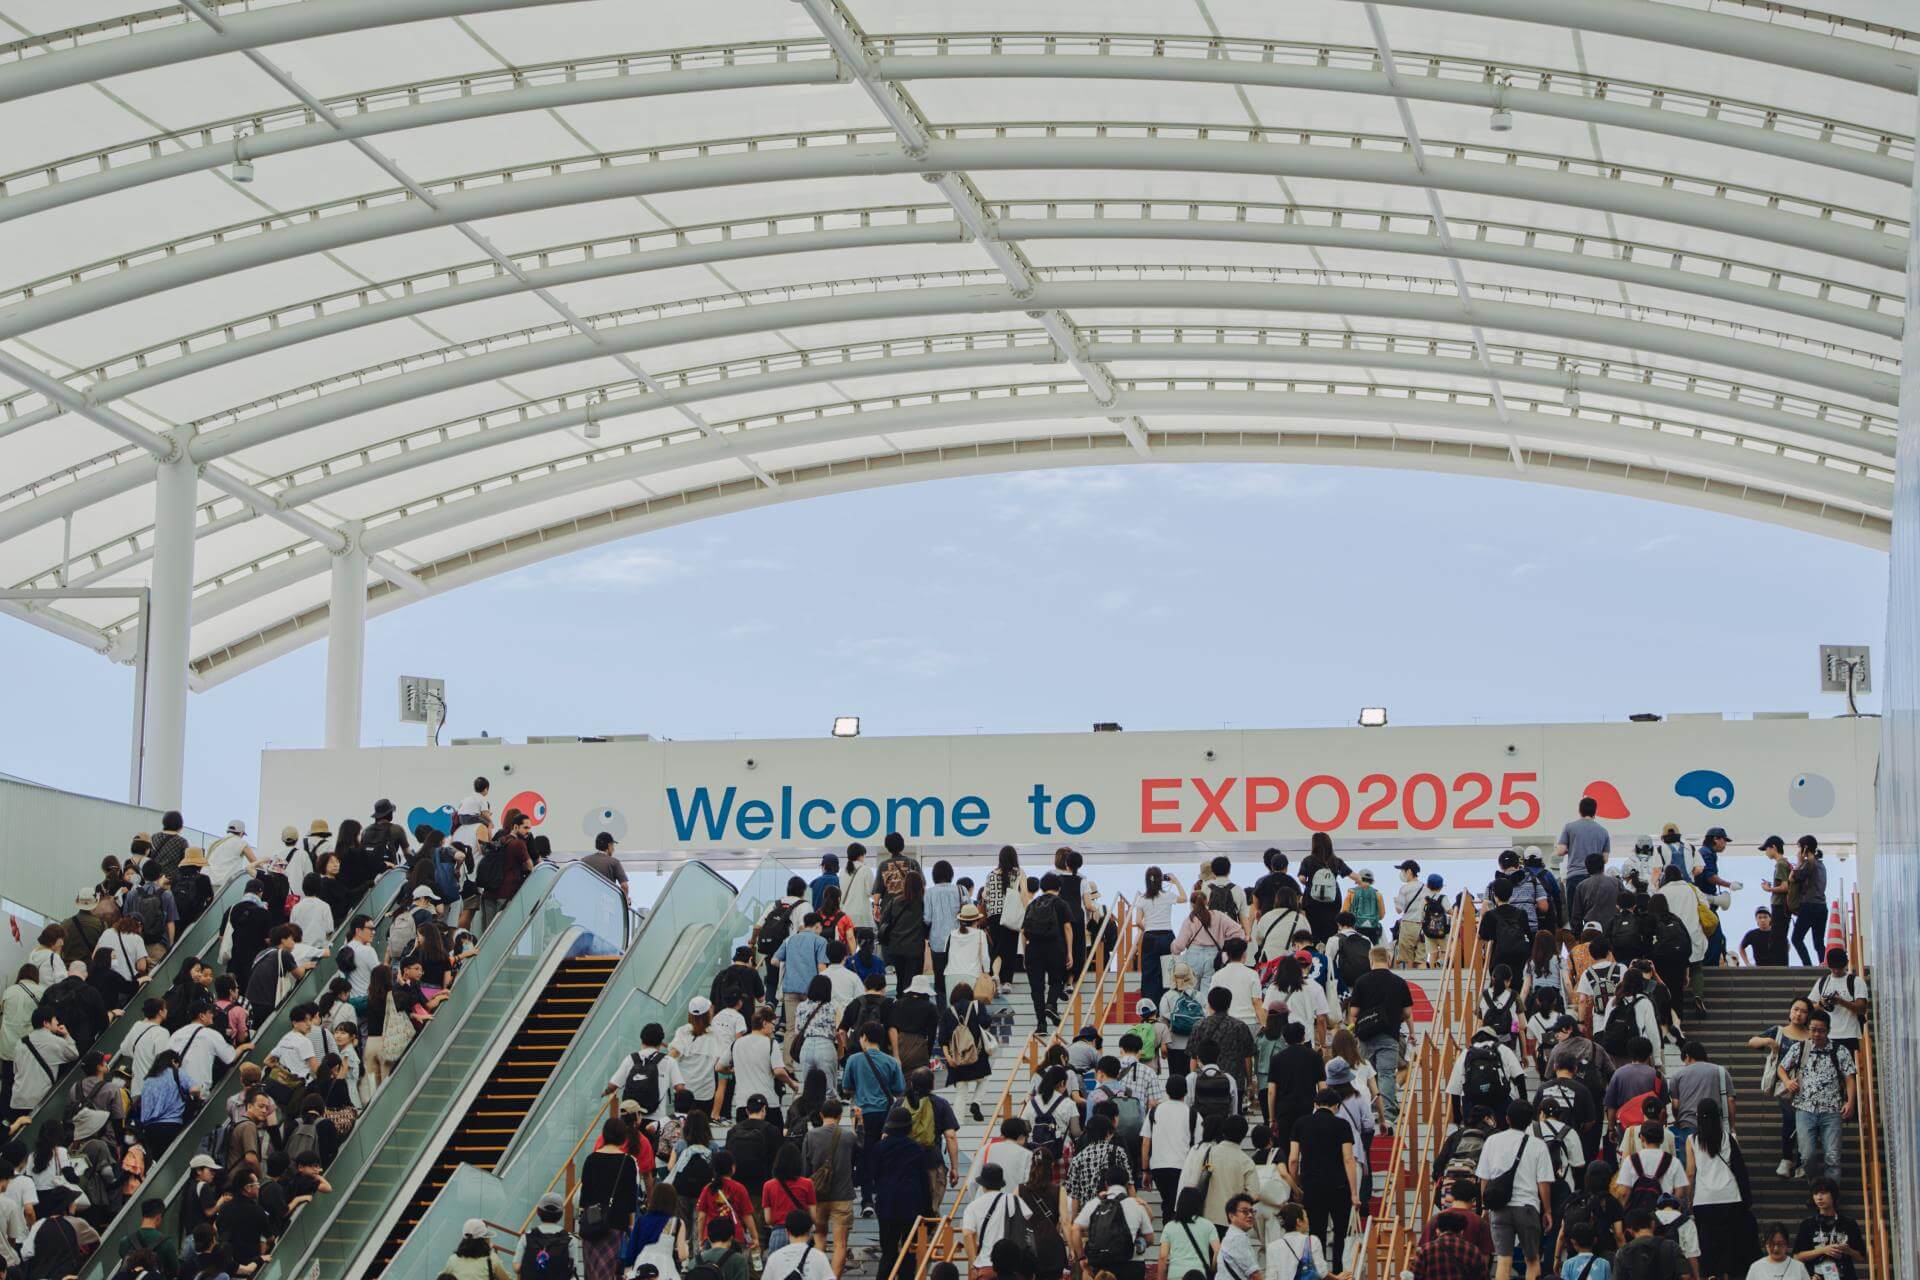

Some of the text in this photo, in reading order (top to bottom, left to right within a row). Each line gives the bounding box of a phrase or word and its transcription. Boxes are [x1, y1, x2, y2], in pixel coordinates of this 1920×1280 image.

[667, 772, 1540, 842] Welcome to EXPO2025
